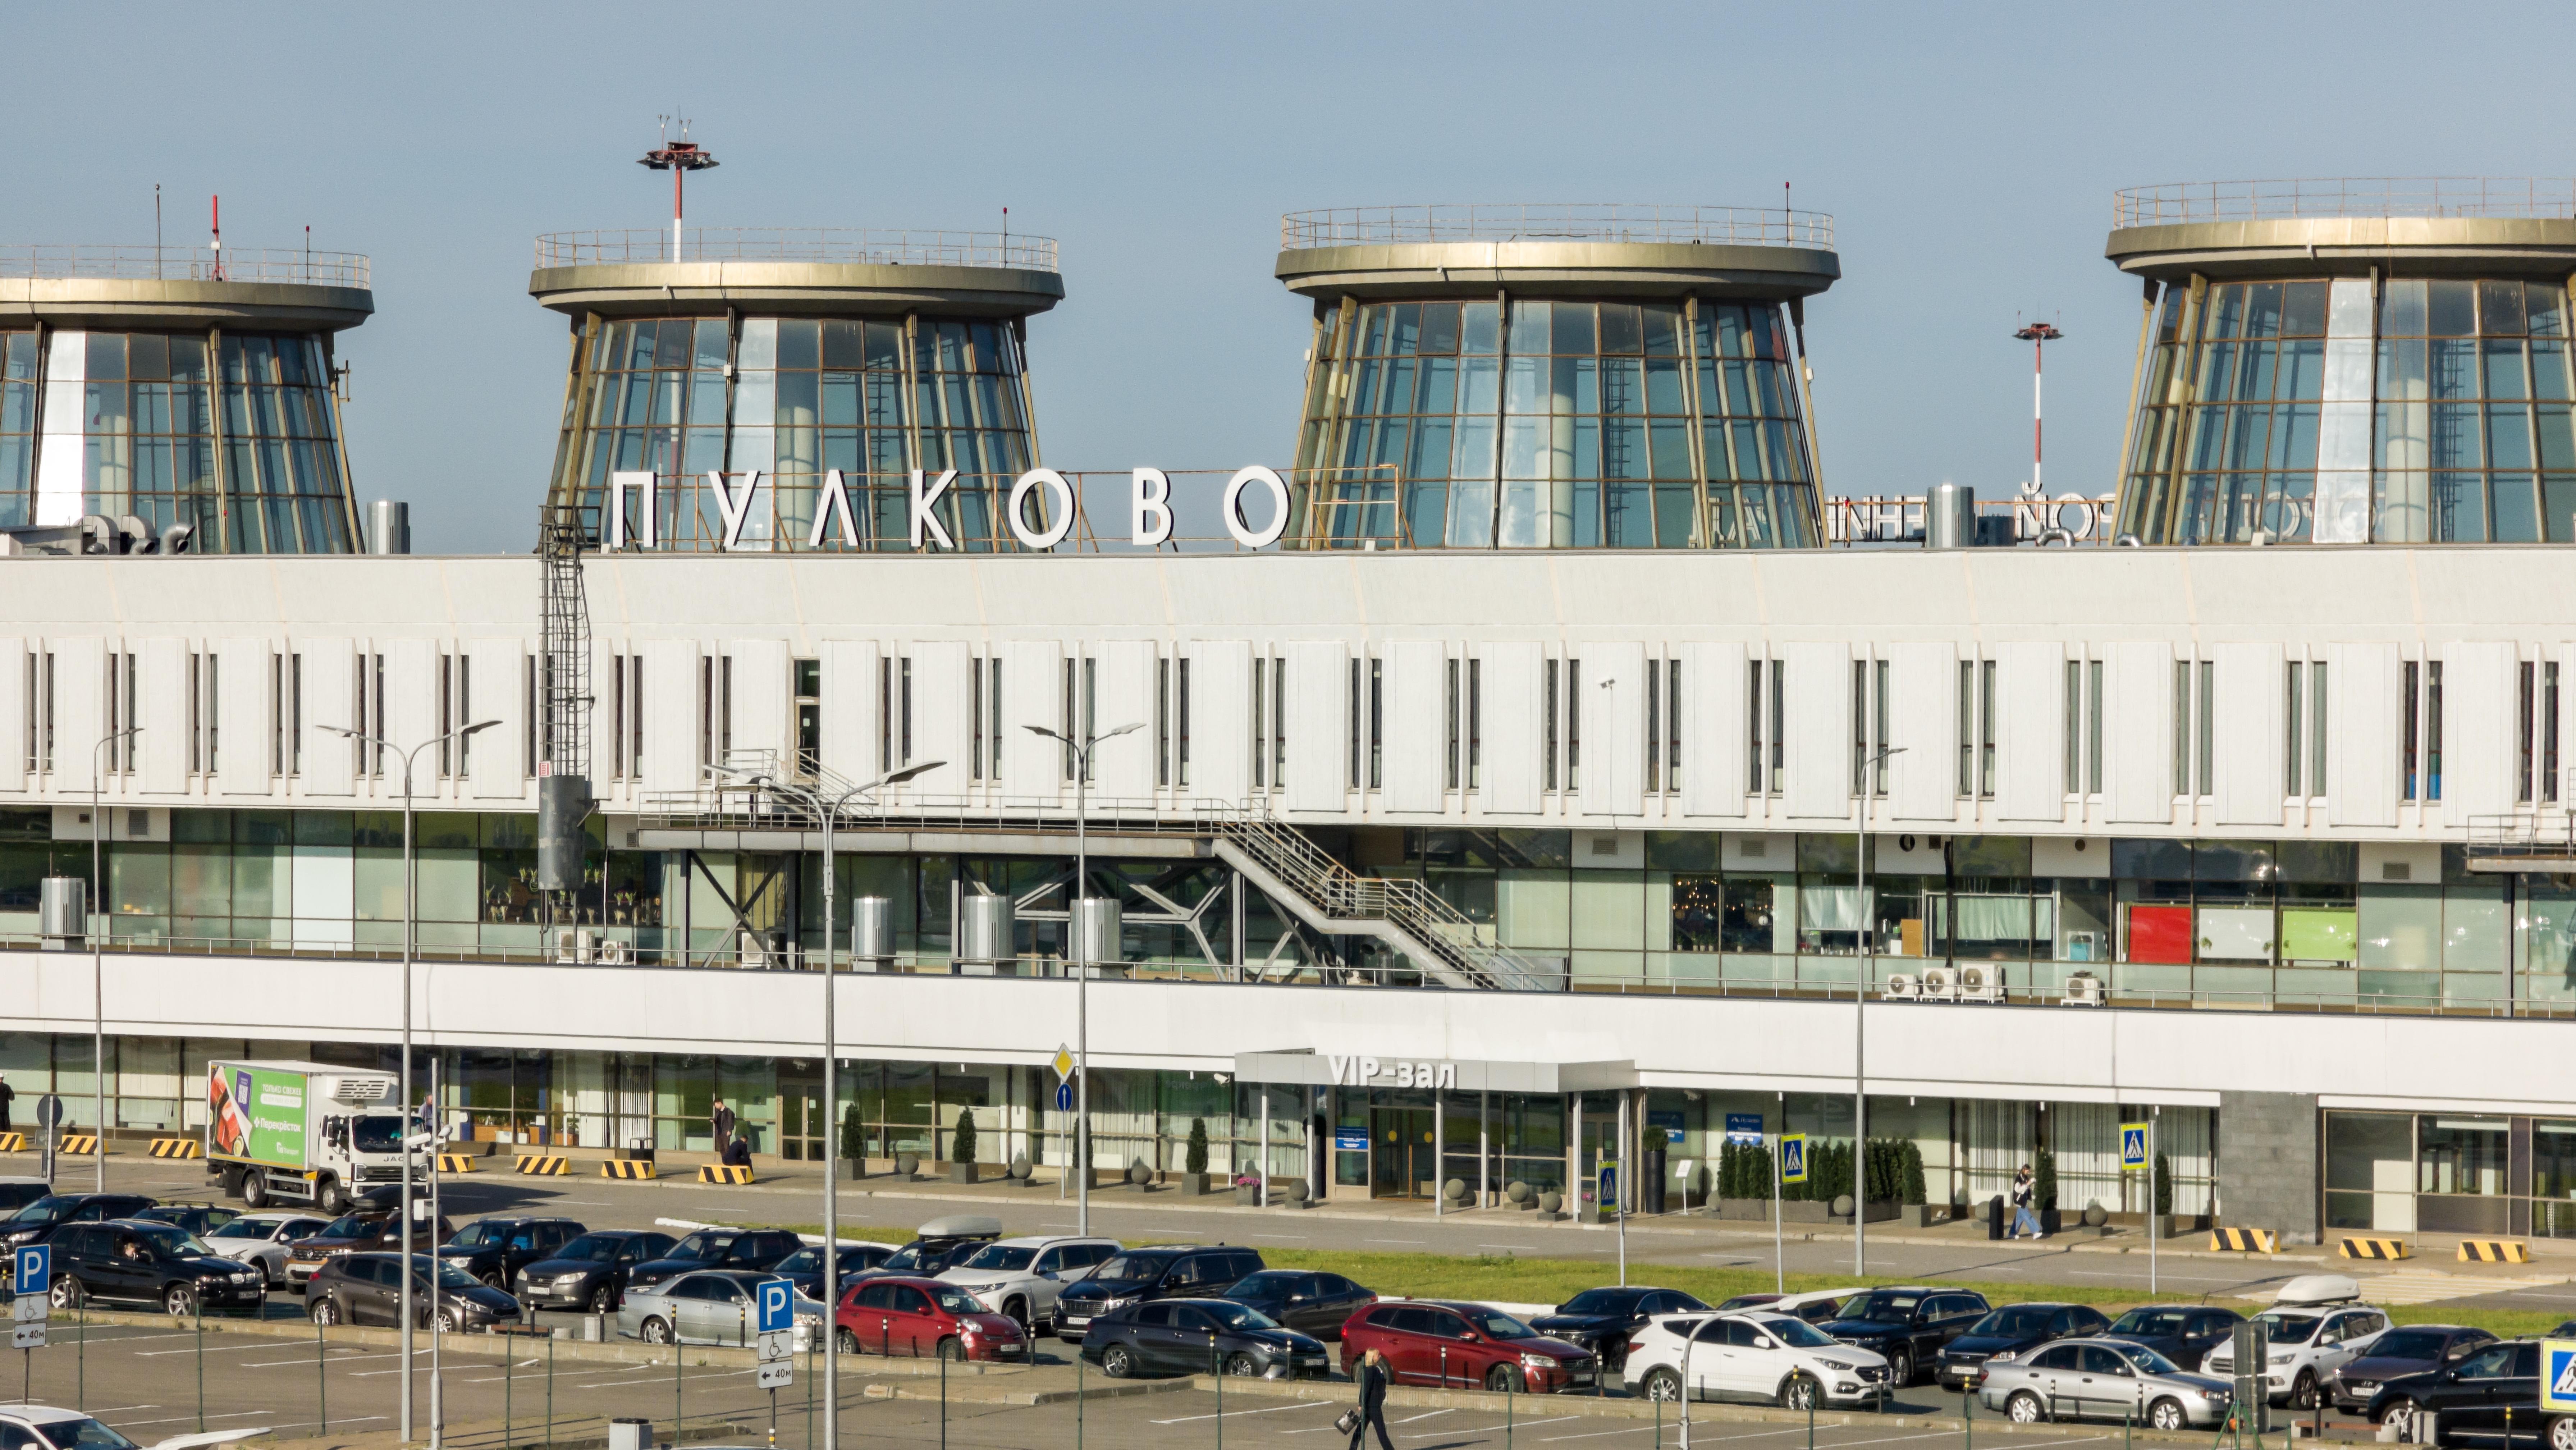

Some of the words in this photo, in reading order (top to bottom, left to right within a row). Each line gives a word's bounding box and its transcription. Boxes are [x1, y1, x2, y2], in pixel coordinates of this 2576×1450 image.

[612, 465, 1291, 548] ПУЛКОВО
[262, 1084, 281, 1093] ТОЛЬКО
[1328, 1055, 1457, 1089] VIP-зал
[260, 1117, 301, 1132] Перекрёсток
[23, 1252, 42, 1288] P
[767, 1287, 786, 1326] P
